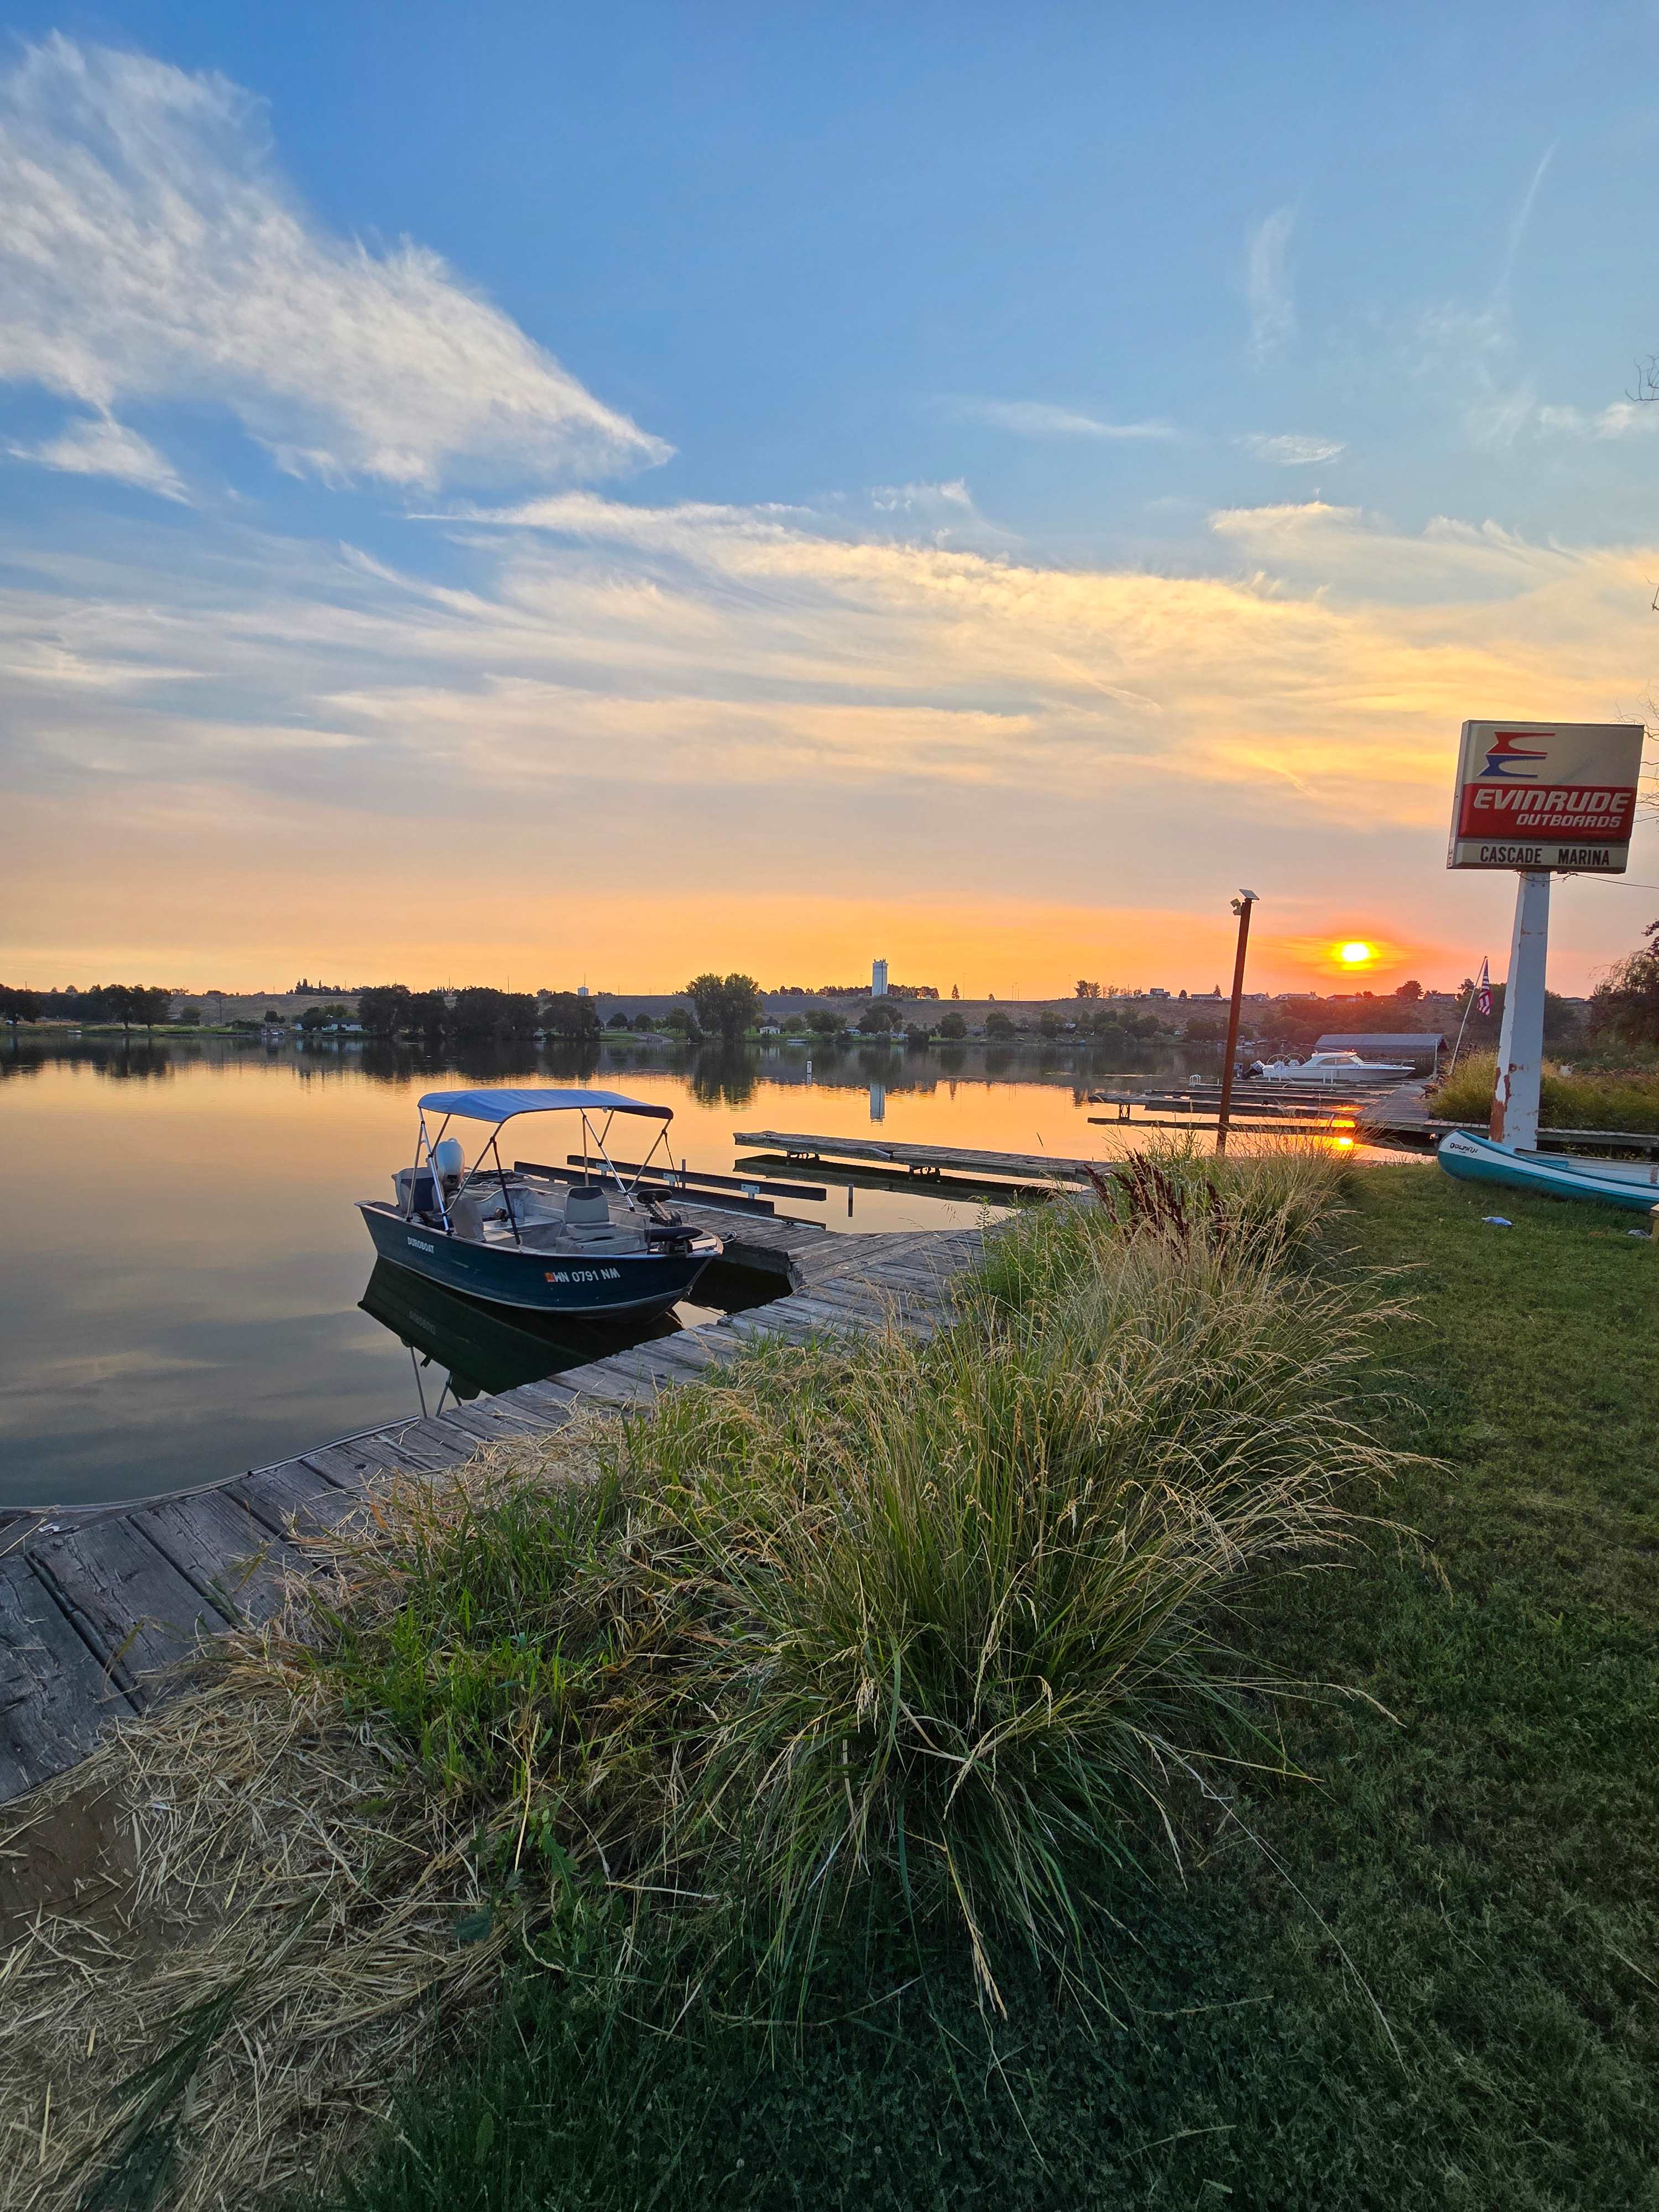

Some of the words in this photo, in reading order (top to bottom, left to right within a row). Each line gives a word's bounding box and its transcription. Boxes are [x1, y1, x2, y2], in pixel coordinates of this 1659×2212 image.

[1473, 789, 1631, 813] EVINRUDE
[1516, 813, 1622, 827] OUTBOARDS
[1480, 846, 1542, 864] CASCADE
[1558, 849, 1609, 865] MARINA
[407, 1237, 434, 1254] DUROBOAT
[553, 1272, 570, 1282] WN
[571, 1270, 599, 1282] 0791
[600, 1268, 621, 1280] NM
